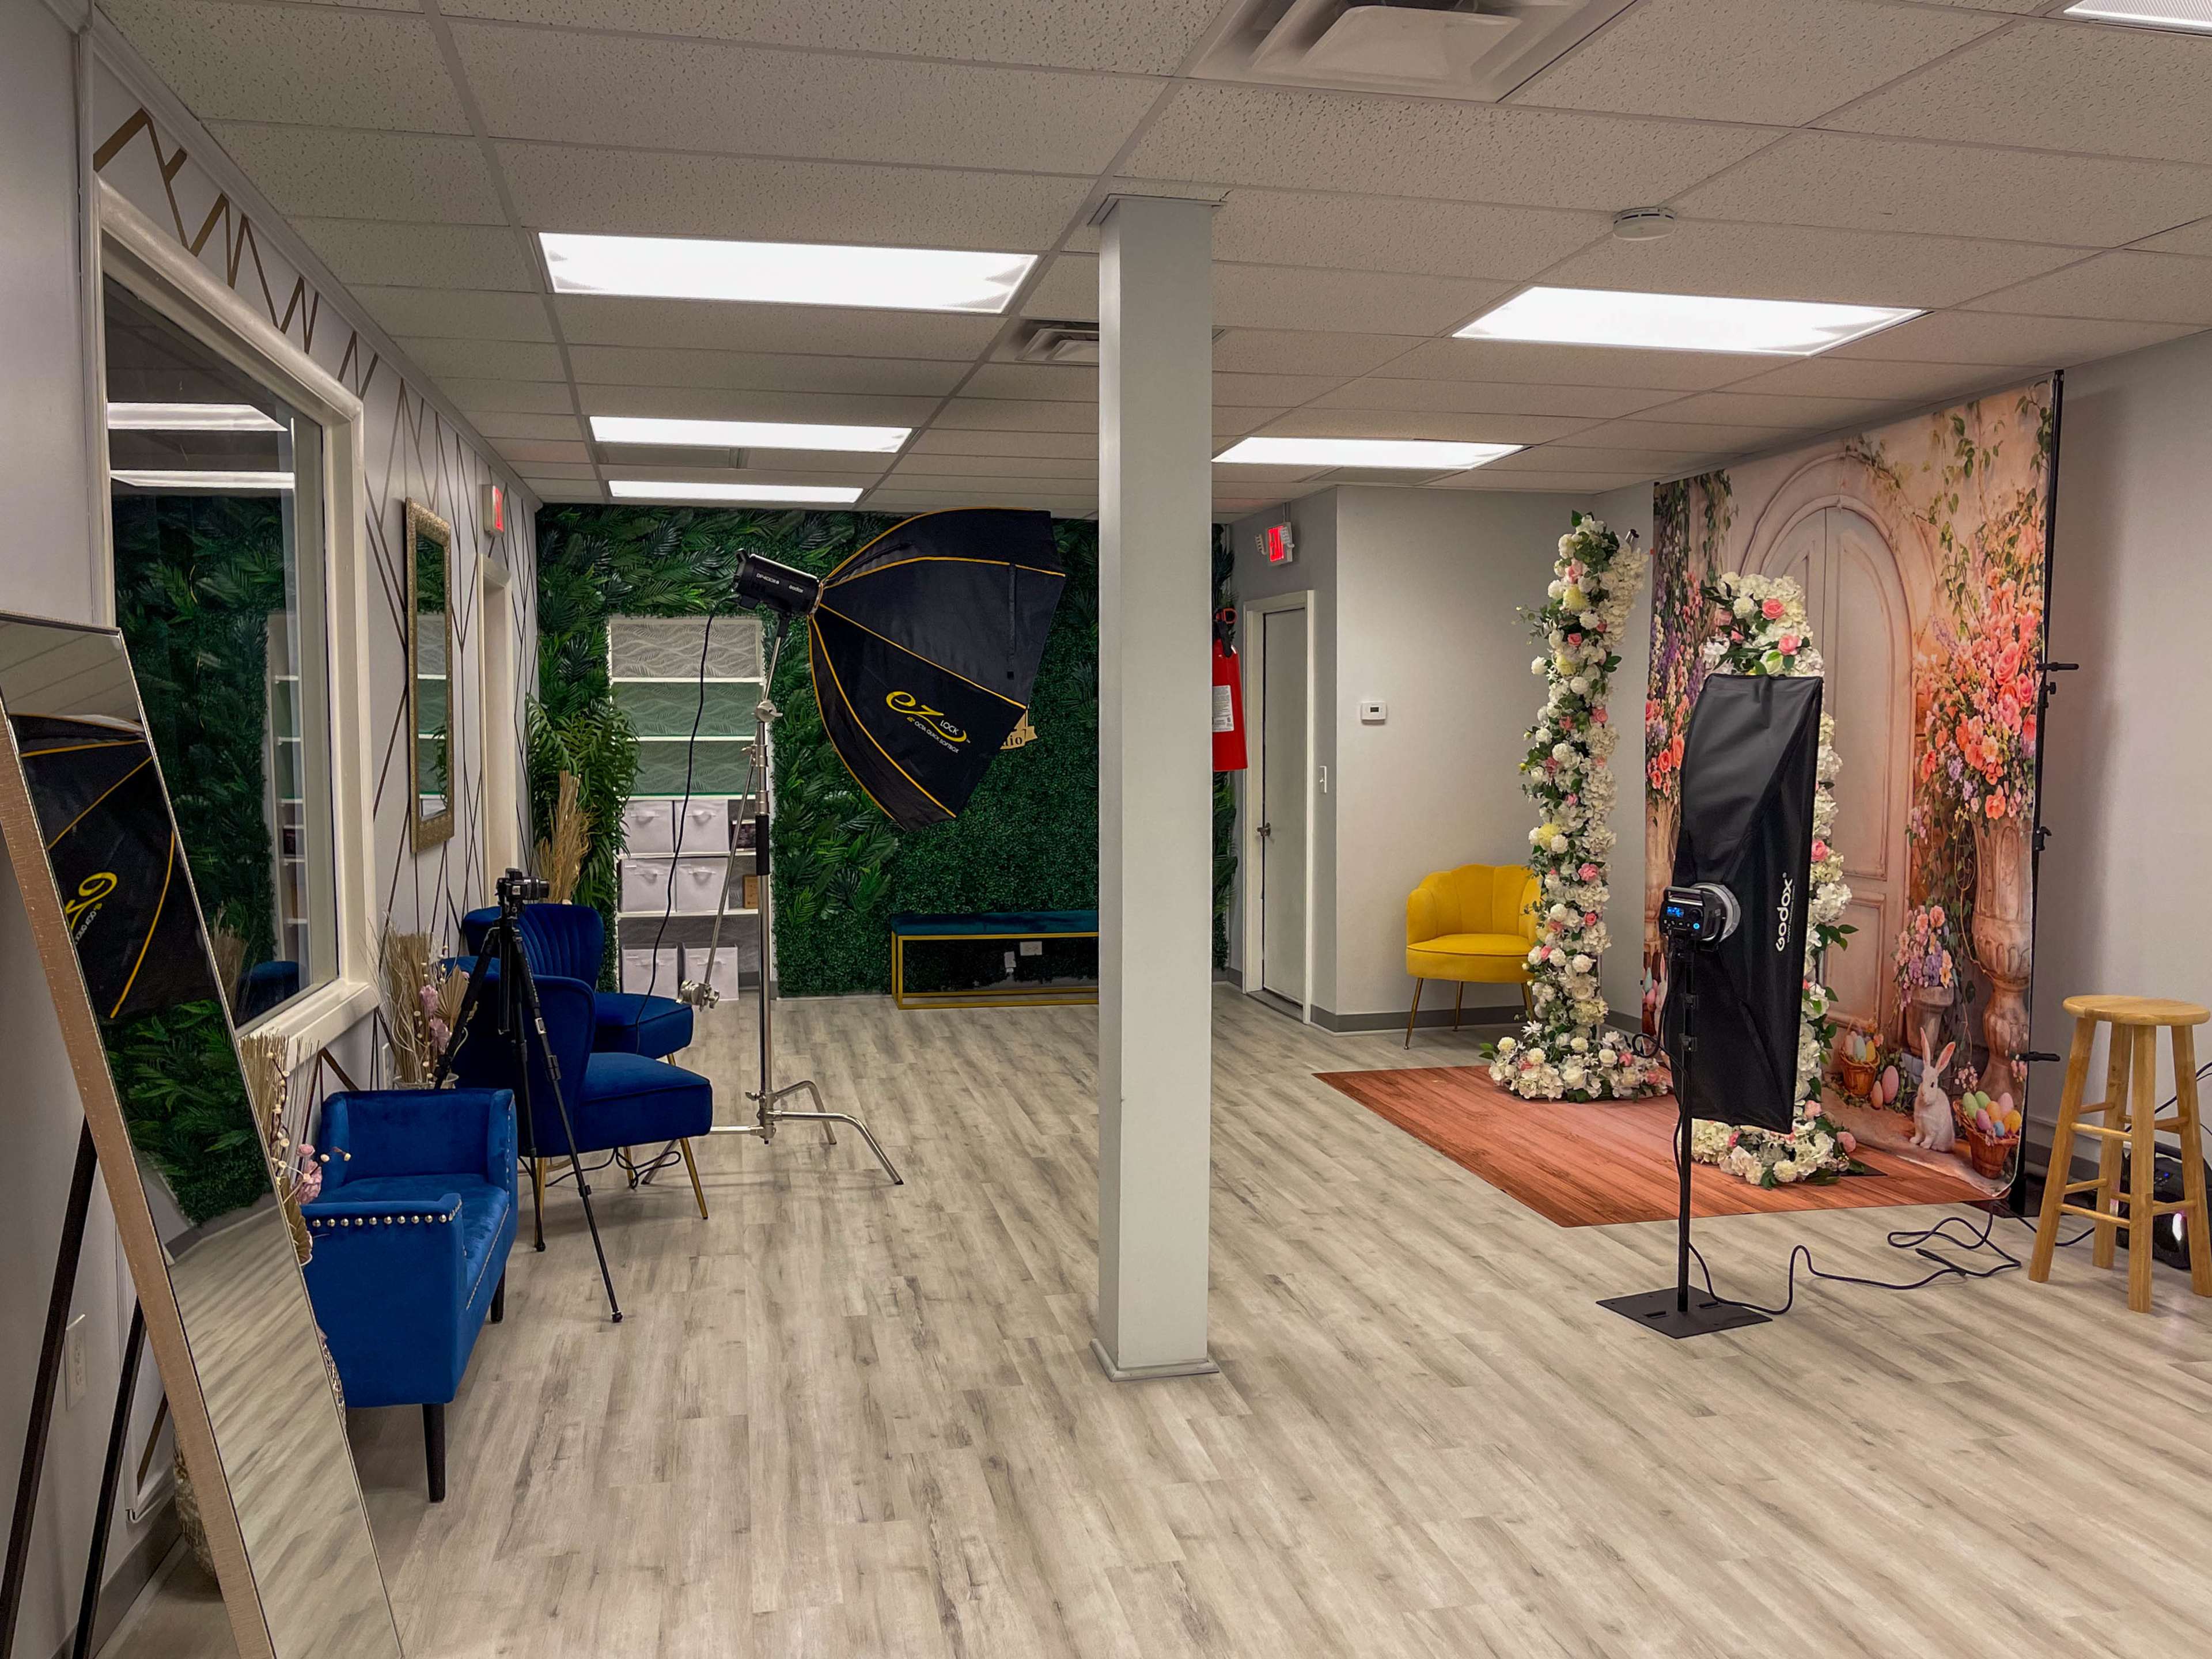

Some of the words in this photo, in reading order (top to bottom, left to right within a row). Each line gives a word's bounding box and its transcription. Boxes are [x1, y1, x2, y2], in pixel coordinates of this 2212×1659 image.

[940, 720, 960, 735] LOCK
[1003, 734, 1022, 747] io
[1775, 878, 1793, 952] Godox
